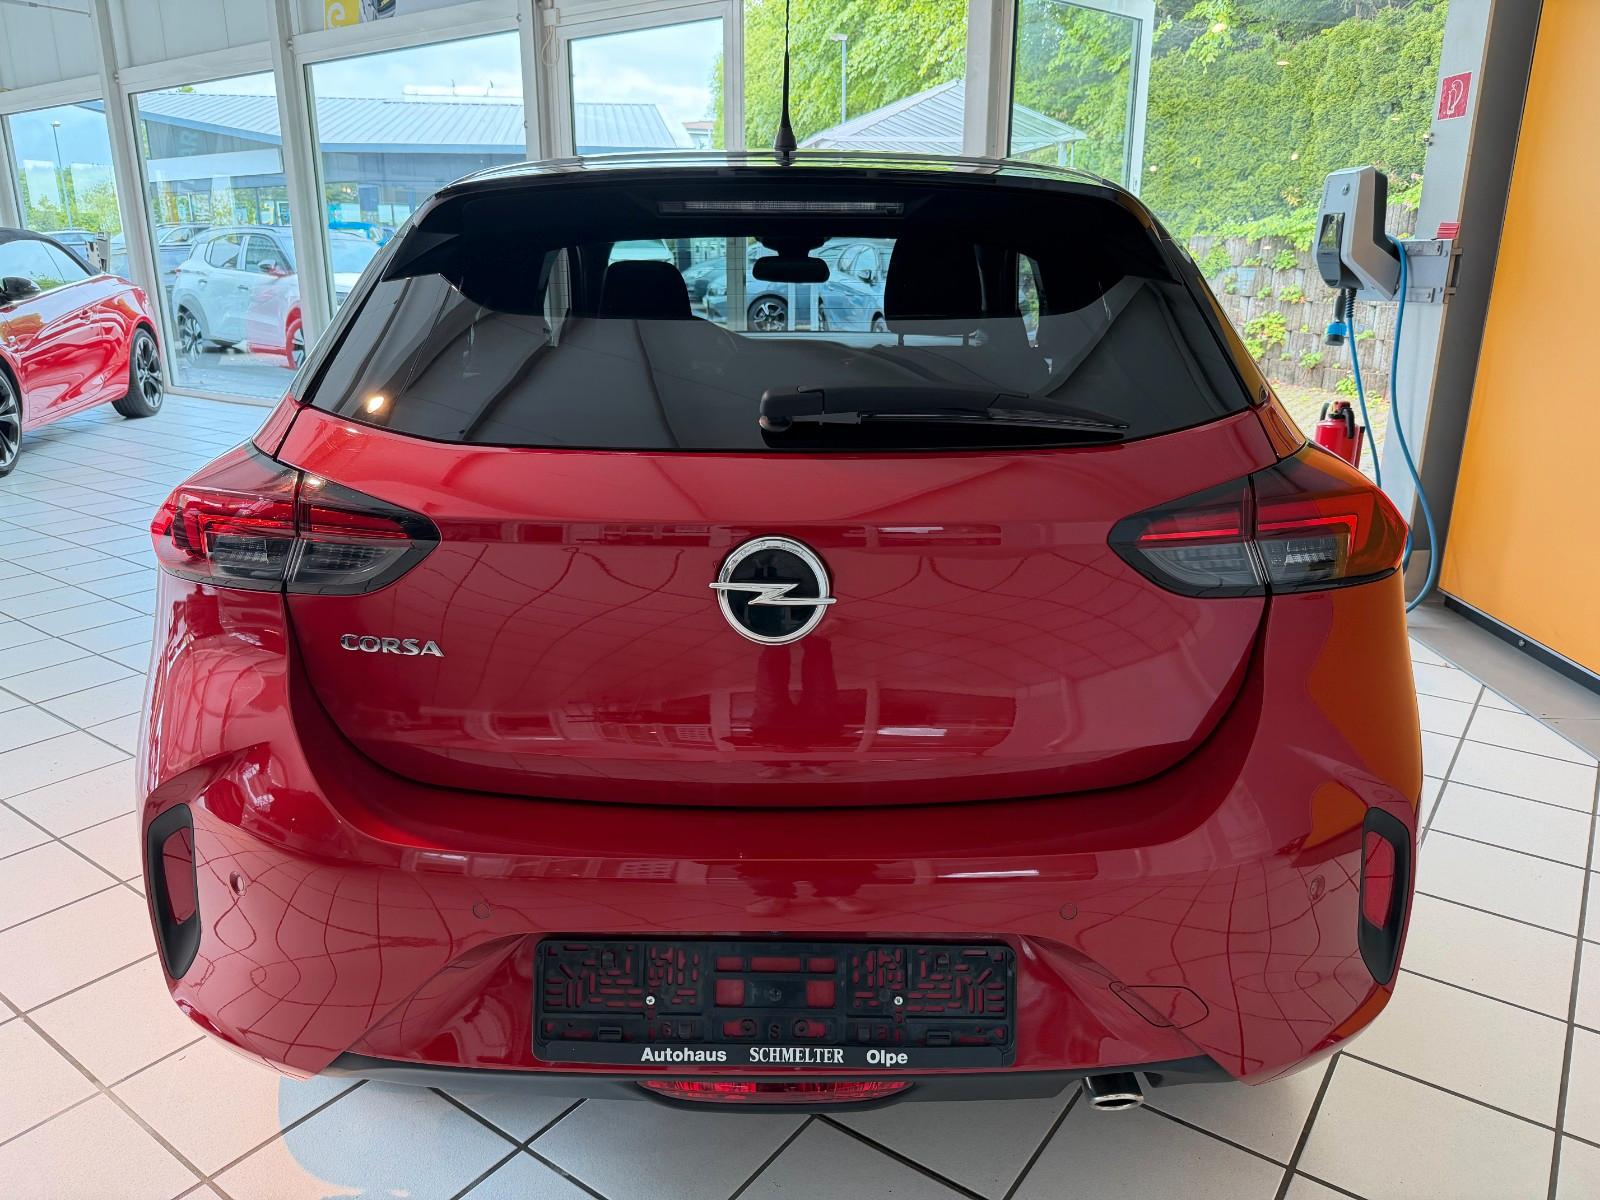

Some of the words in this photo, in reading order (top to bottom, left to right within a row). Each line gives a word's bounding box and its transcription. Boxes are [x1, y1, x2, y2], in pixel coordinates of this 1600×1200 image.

[341, 633, 445, 657] CORSA
[640, 1047, 727, 1062] Autohaus
[749, 1047, 844, 1064] SCHMELTER
[866, 1049, 908, 1067] Olpe
